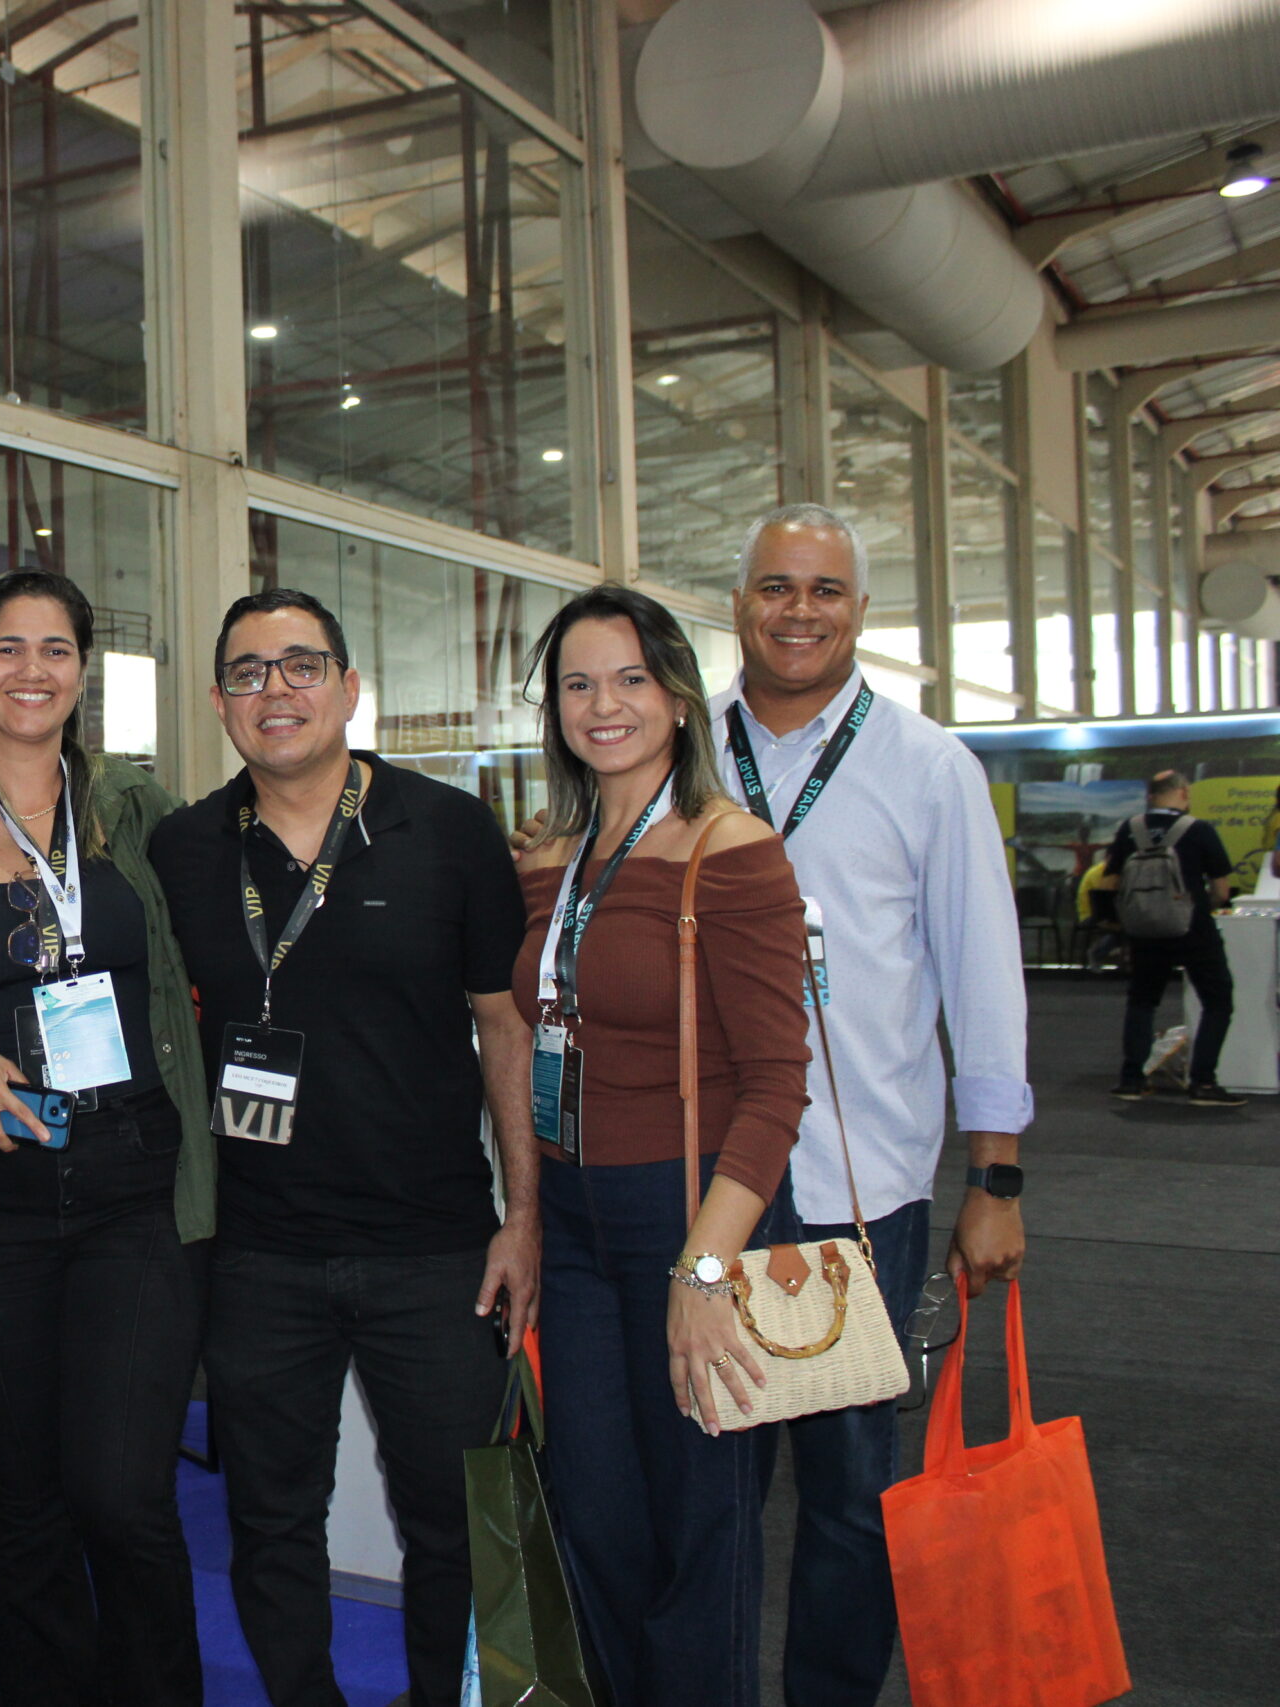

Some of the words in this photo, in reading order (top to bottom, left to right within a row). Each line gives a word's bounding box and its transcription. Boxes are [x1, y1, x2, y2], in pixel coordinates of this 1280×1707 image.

[847, 689, 871, 734] START
[736, 756, 761, 796] START
[339, 788, 358, 818] VIP
[791, 777, 823, 822] START
[239, 806, 252, 832] VIP
[51, 849, 66, 877] VIP
[312, 864, 333, 895] VIP
[245, 886, 264, 919] VIP
[42, 923, 59, 956] VIP
[271, 941, 293, 970] VIP
